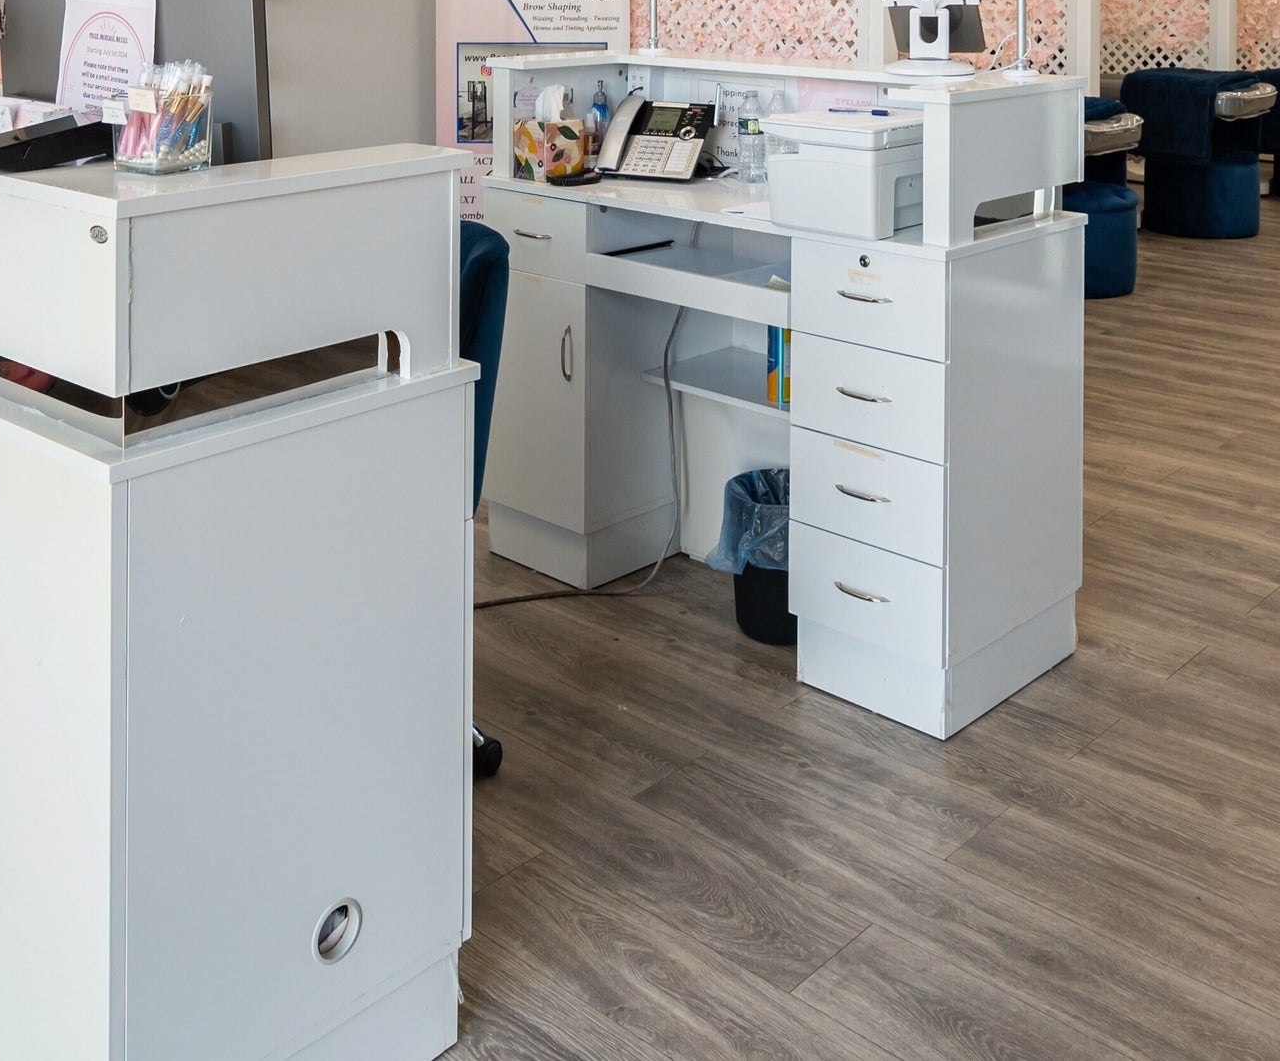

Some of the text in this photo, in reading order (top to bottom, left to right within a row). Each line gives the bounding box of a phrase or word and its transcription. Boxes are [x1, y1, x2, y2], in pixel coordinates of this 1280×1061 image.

[522, 3, 582, 13] Brow Shaping
[593, 15, 620, 23] Tweezing
[117, 66, 128, 74] there
[111, 76, 128, 84] increase
[95, 84, 111, 92] services
[720, 86, 747, 100] ipping
[716, 145, 739, 158] Thank
